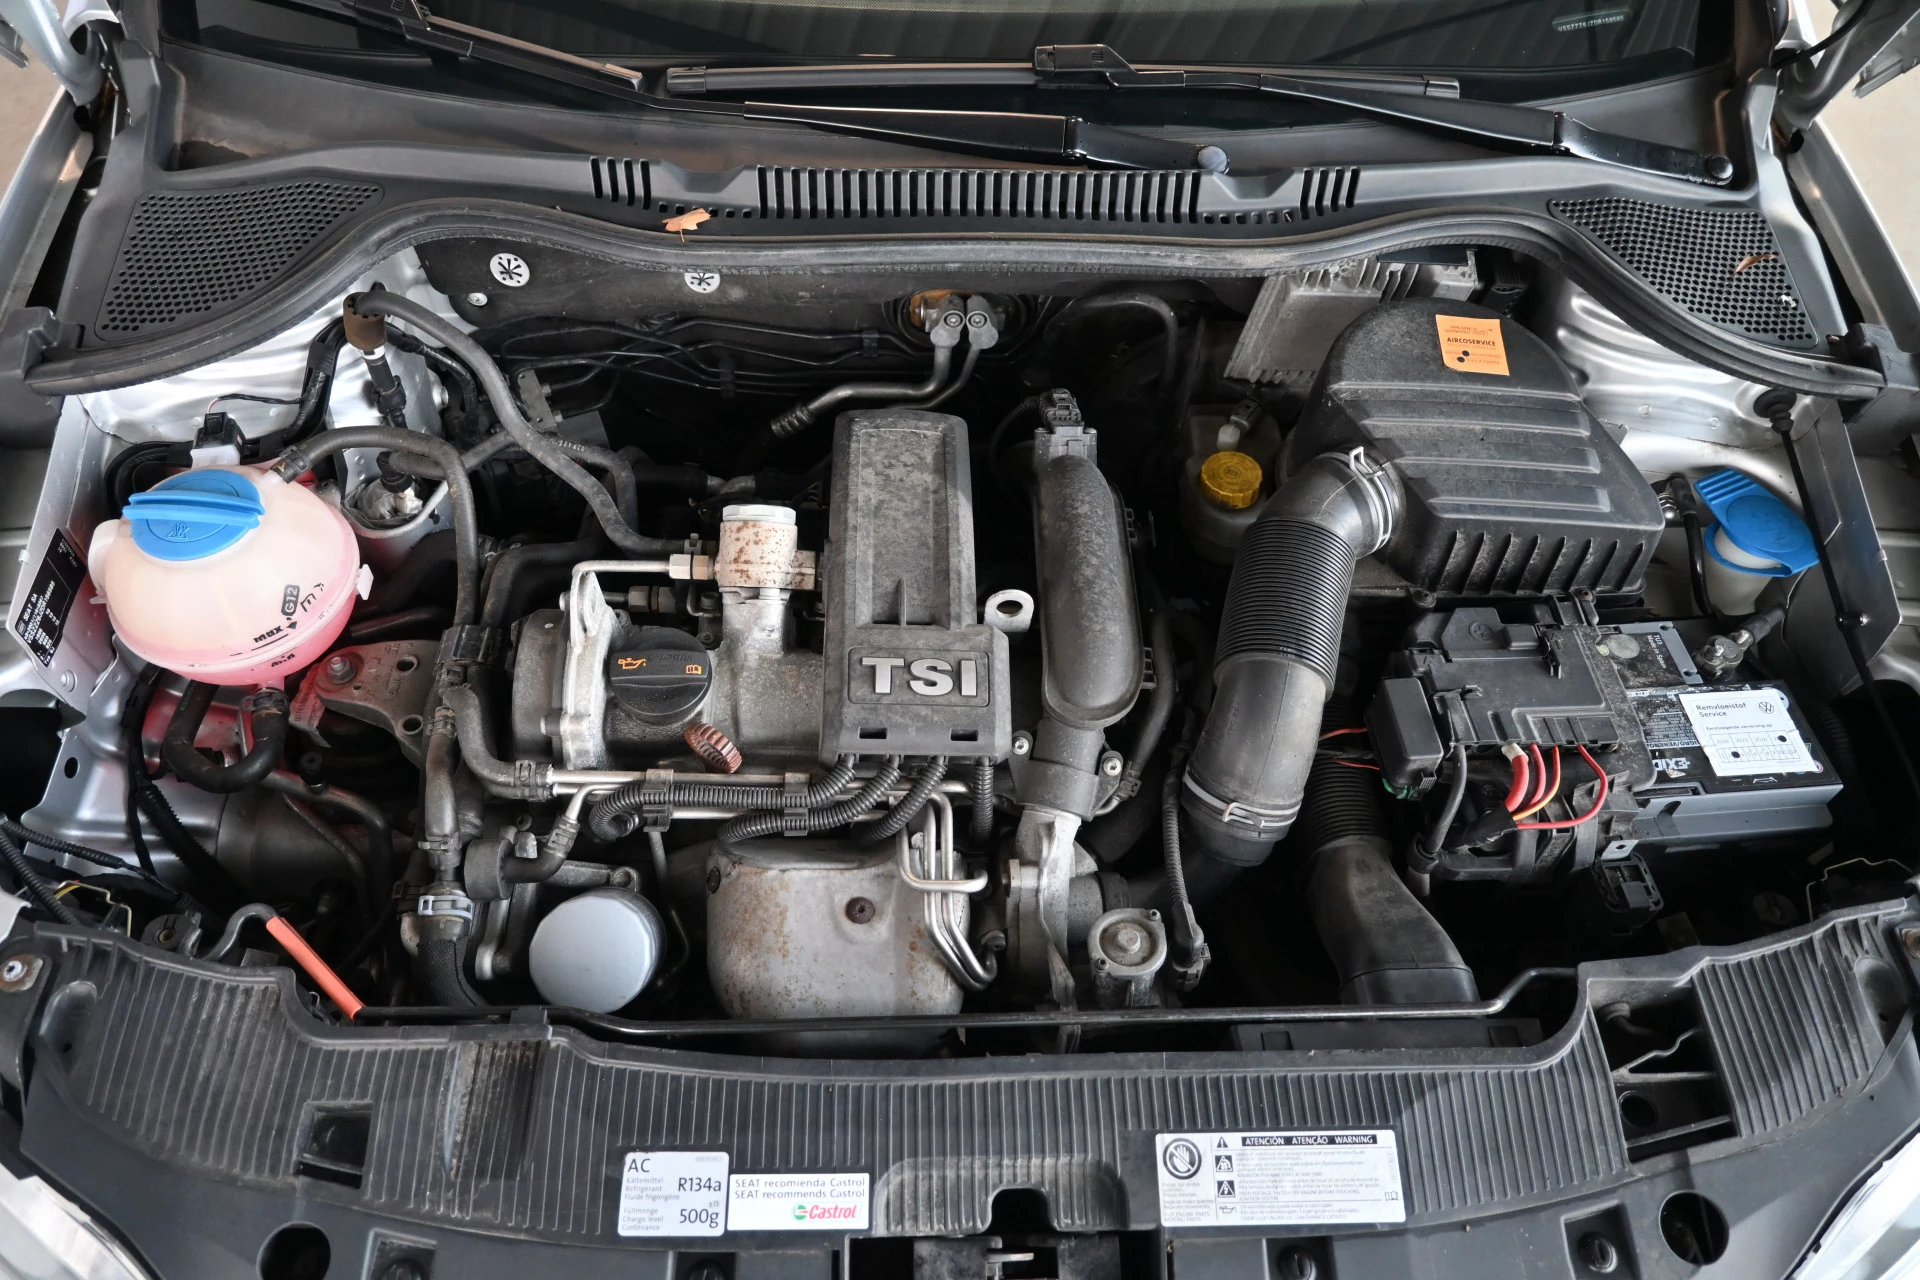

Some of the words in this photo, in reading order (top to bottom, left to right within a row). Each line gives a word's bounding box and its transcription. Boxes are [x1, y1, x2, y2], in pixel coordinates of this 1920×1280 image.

[1447, 337, 1496, 346] AIRCOSERVICE
[285, 587, 298, 613] G12
[23, 604, 32, 621] SEAT
[253, 625, 283, 643] max
[1657, 654, 1666, 668] Spain
[862, 657, 976, 696] TSI
[1696, 703, 1746, 711] Remvloeistof
[1652, 758, 1690, 771] EXID
[1245, 1135, 1285, 1146] ATENCIÓN
[1292, 1135, 1328, 1146] ATENÇÃO
[1334, 1135, 1373, 1144] WARNING
[628, 1158, 650, 1172] AC
[626, 1185, 662, 1193] Refrigerant
[678, 1177, 722, 1192] R134a
[735, 1179, 760, 1188] SEAT
[765, 1178, 826, 1188] recomienda
[830, 1177, 865, 1187] Castrol
[735, 1190, 759, 1199] SEAT
[762, 1189, 827, 1198] recommends
[830, 1188, 865, 1198] Castrol
[680, 1208, 719, 1228] 500g
[809, 1204, 857, 1219] Castrol
